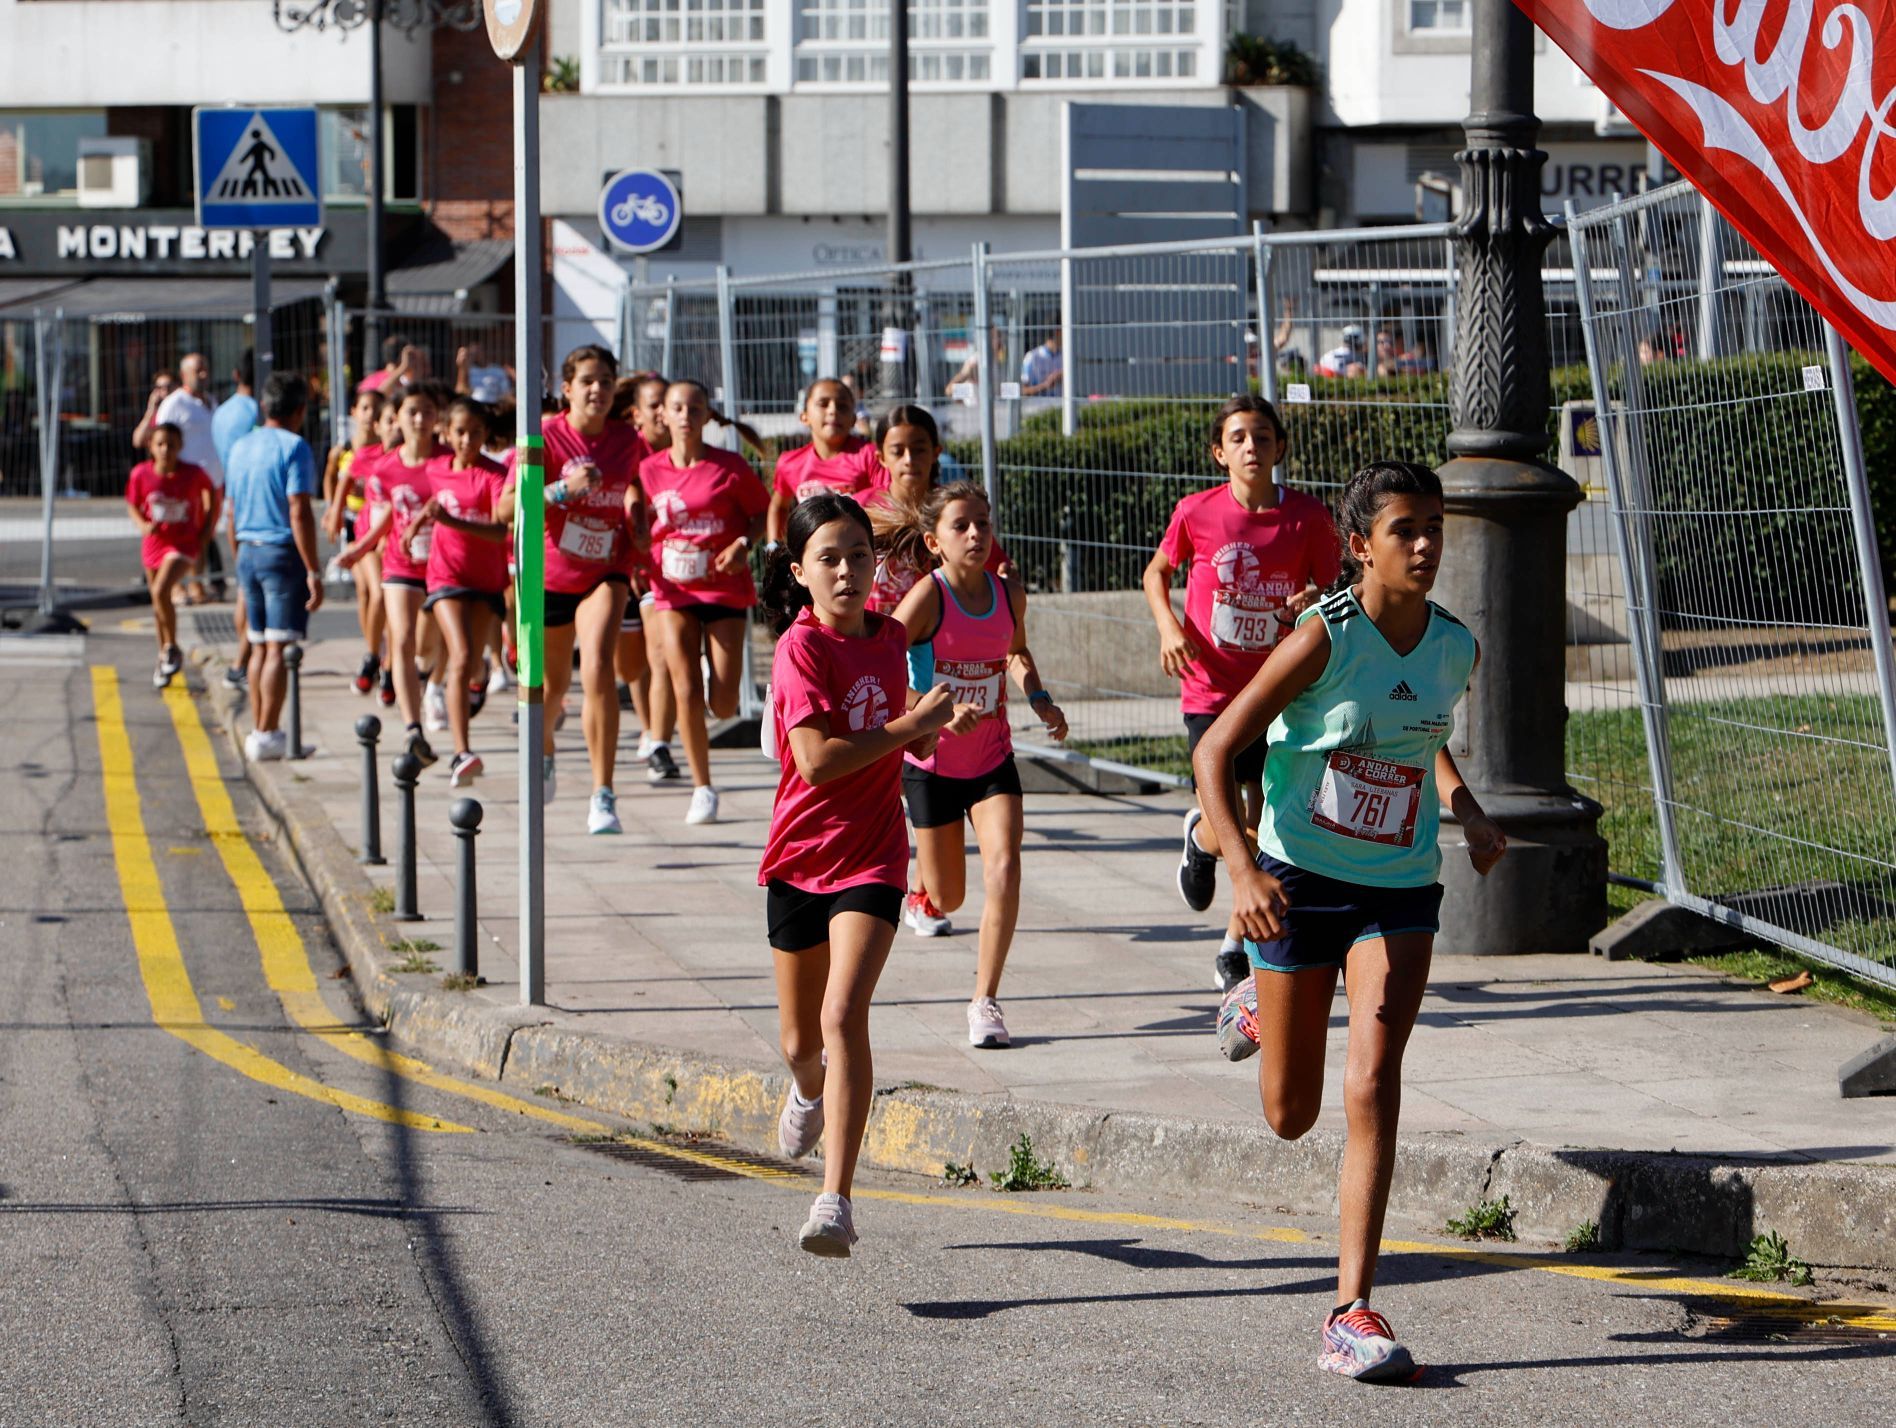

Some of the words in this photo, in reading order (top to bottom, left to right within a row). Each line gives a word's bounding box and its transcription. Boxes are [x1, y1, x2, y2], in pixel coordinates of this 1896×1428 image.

[578, 534, 604, 554] 785
[1236, 592, 1267, 603] ANDAR
[1233, 616, 1267, 641] 793
[841, 675, 881, 712] FINISHER!
[955, 685, 987, 709] 773
[1389, 693, 1418, 701] adidas
[1358, 760, 1397, 774] ANDAR
[1365, 768, 1407, 784] CORRER
[1350, 790, 1390, 829] 761
